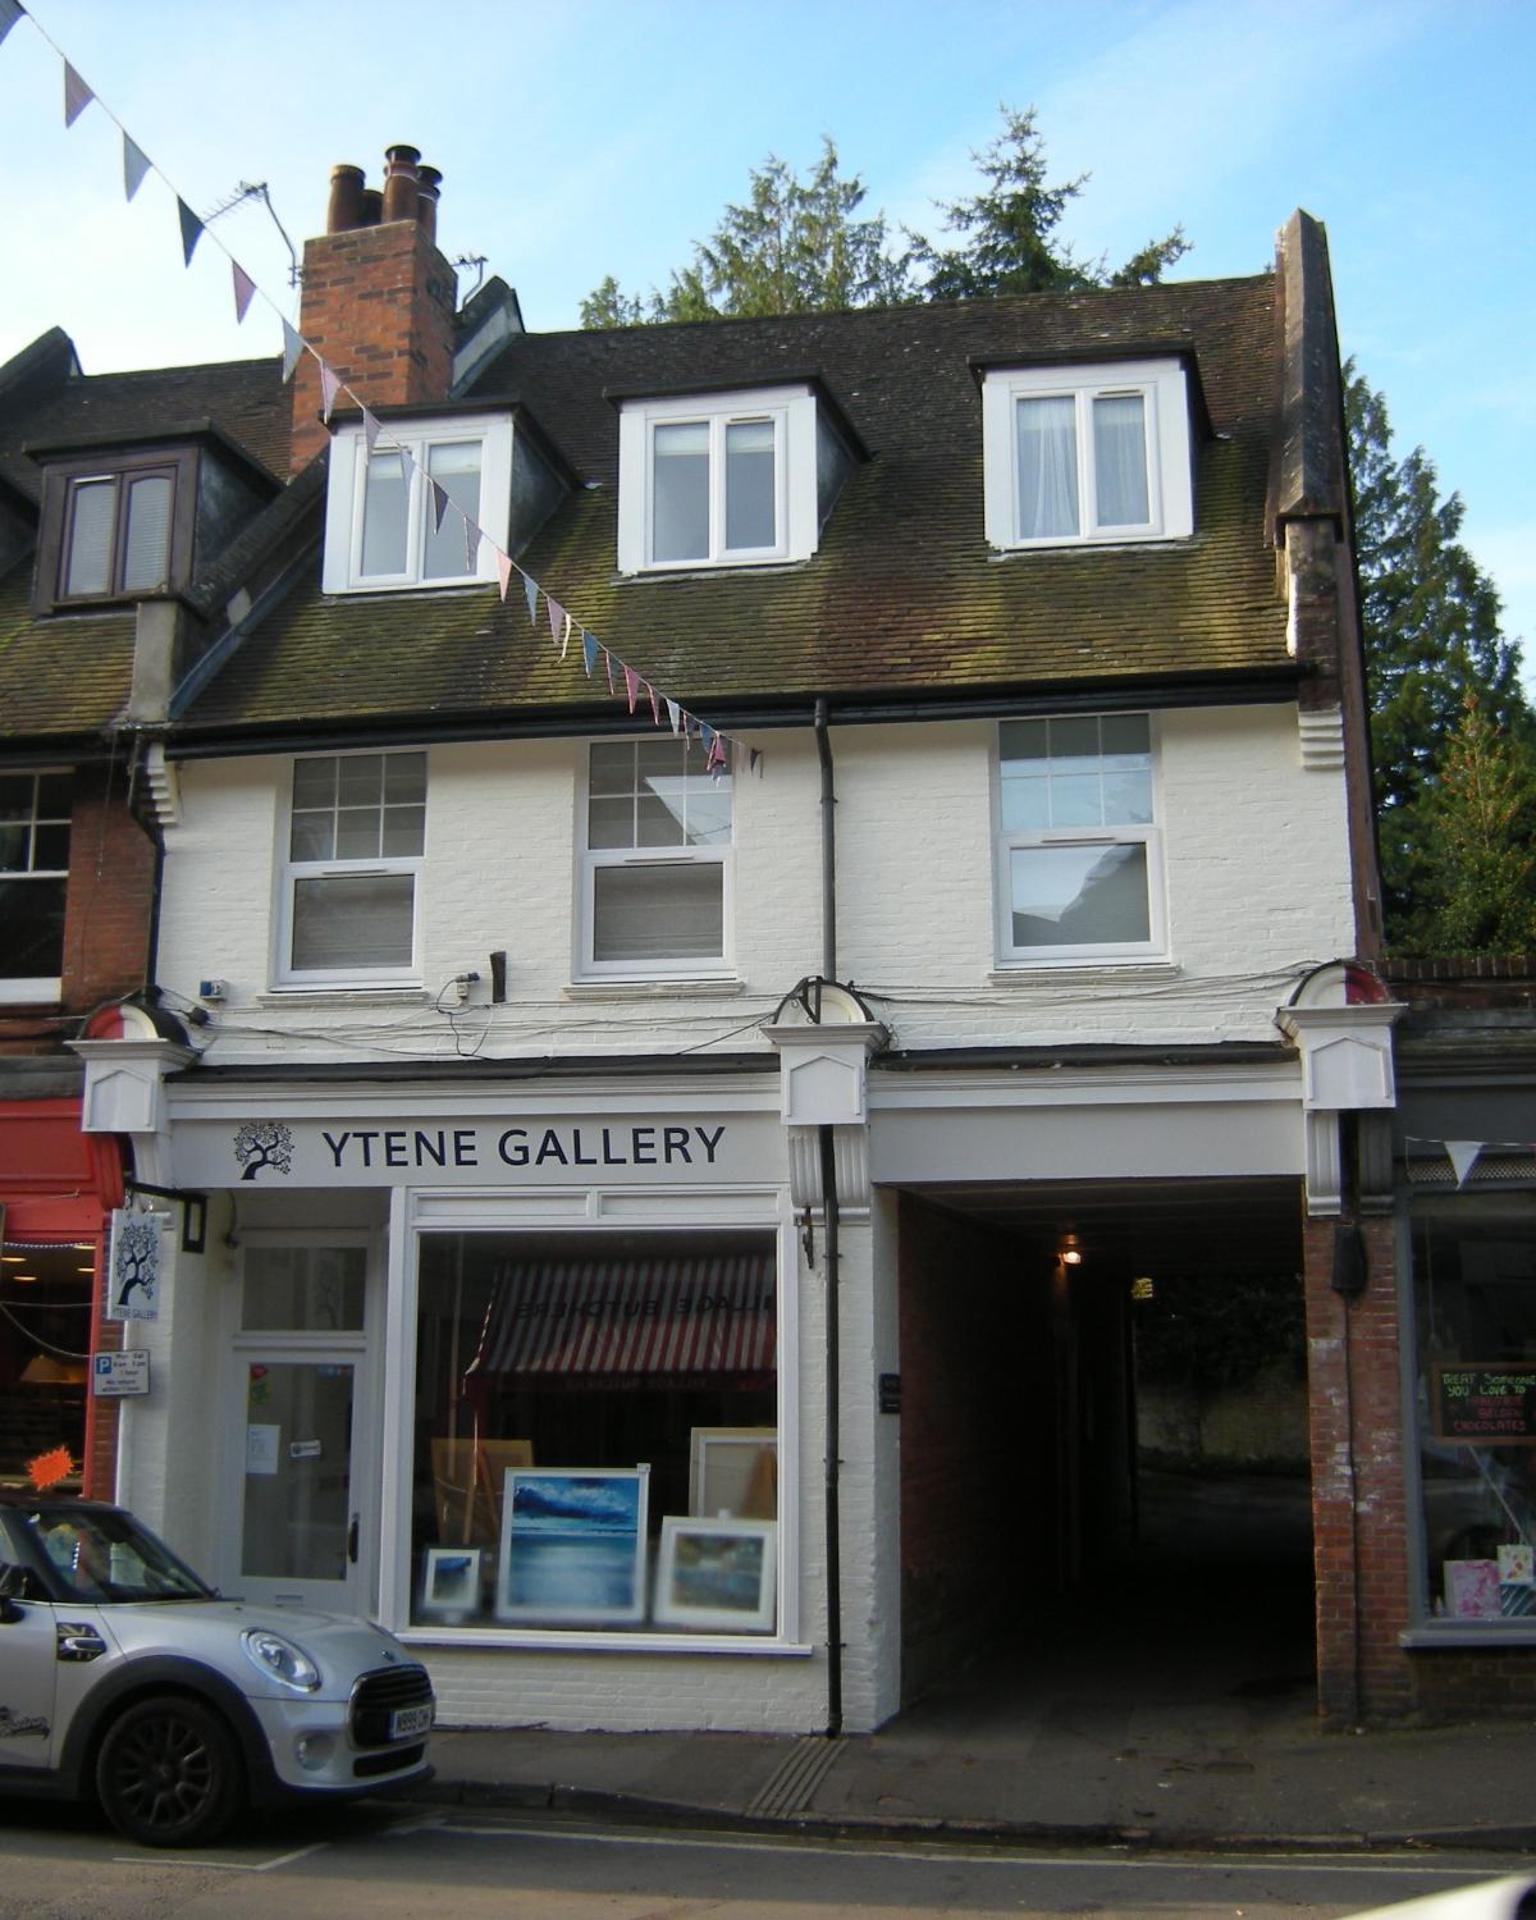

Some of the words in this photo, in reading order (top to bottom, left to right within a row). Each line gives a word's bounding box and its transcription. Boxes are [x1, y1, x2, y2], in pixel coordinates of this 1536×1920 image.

[322, 1130, 479, 1167] YTENE
[498, 1126, 726, 1166] GALLERY
[1447, 1385, 1470, 1397] YOU
[1514, 1384, 1526, 1394] TO
